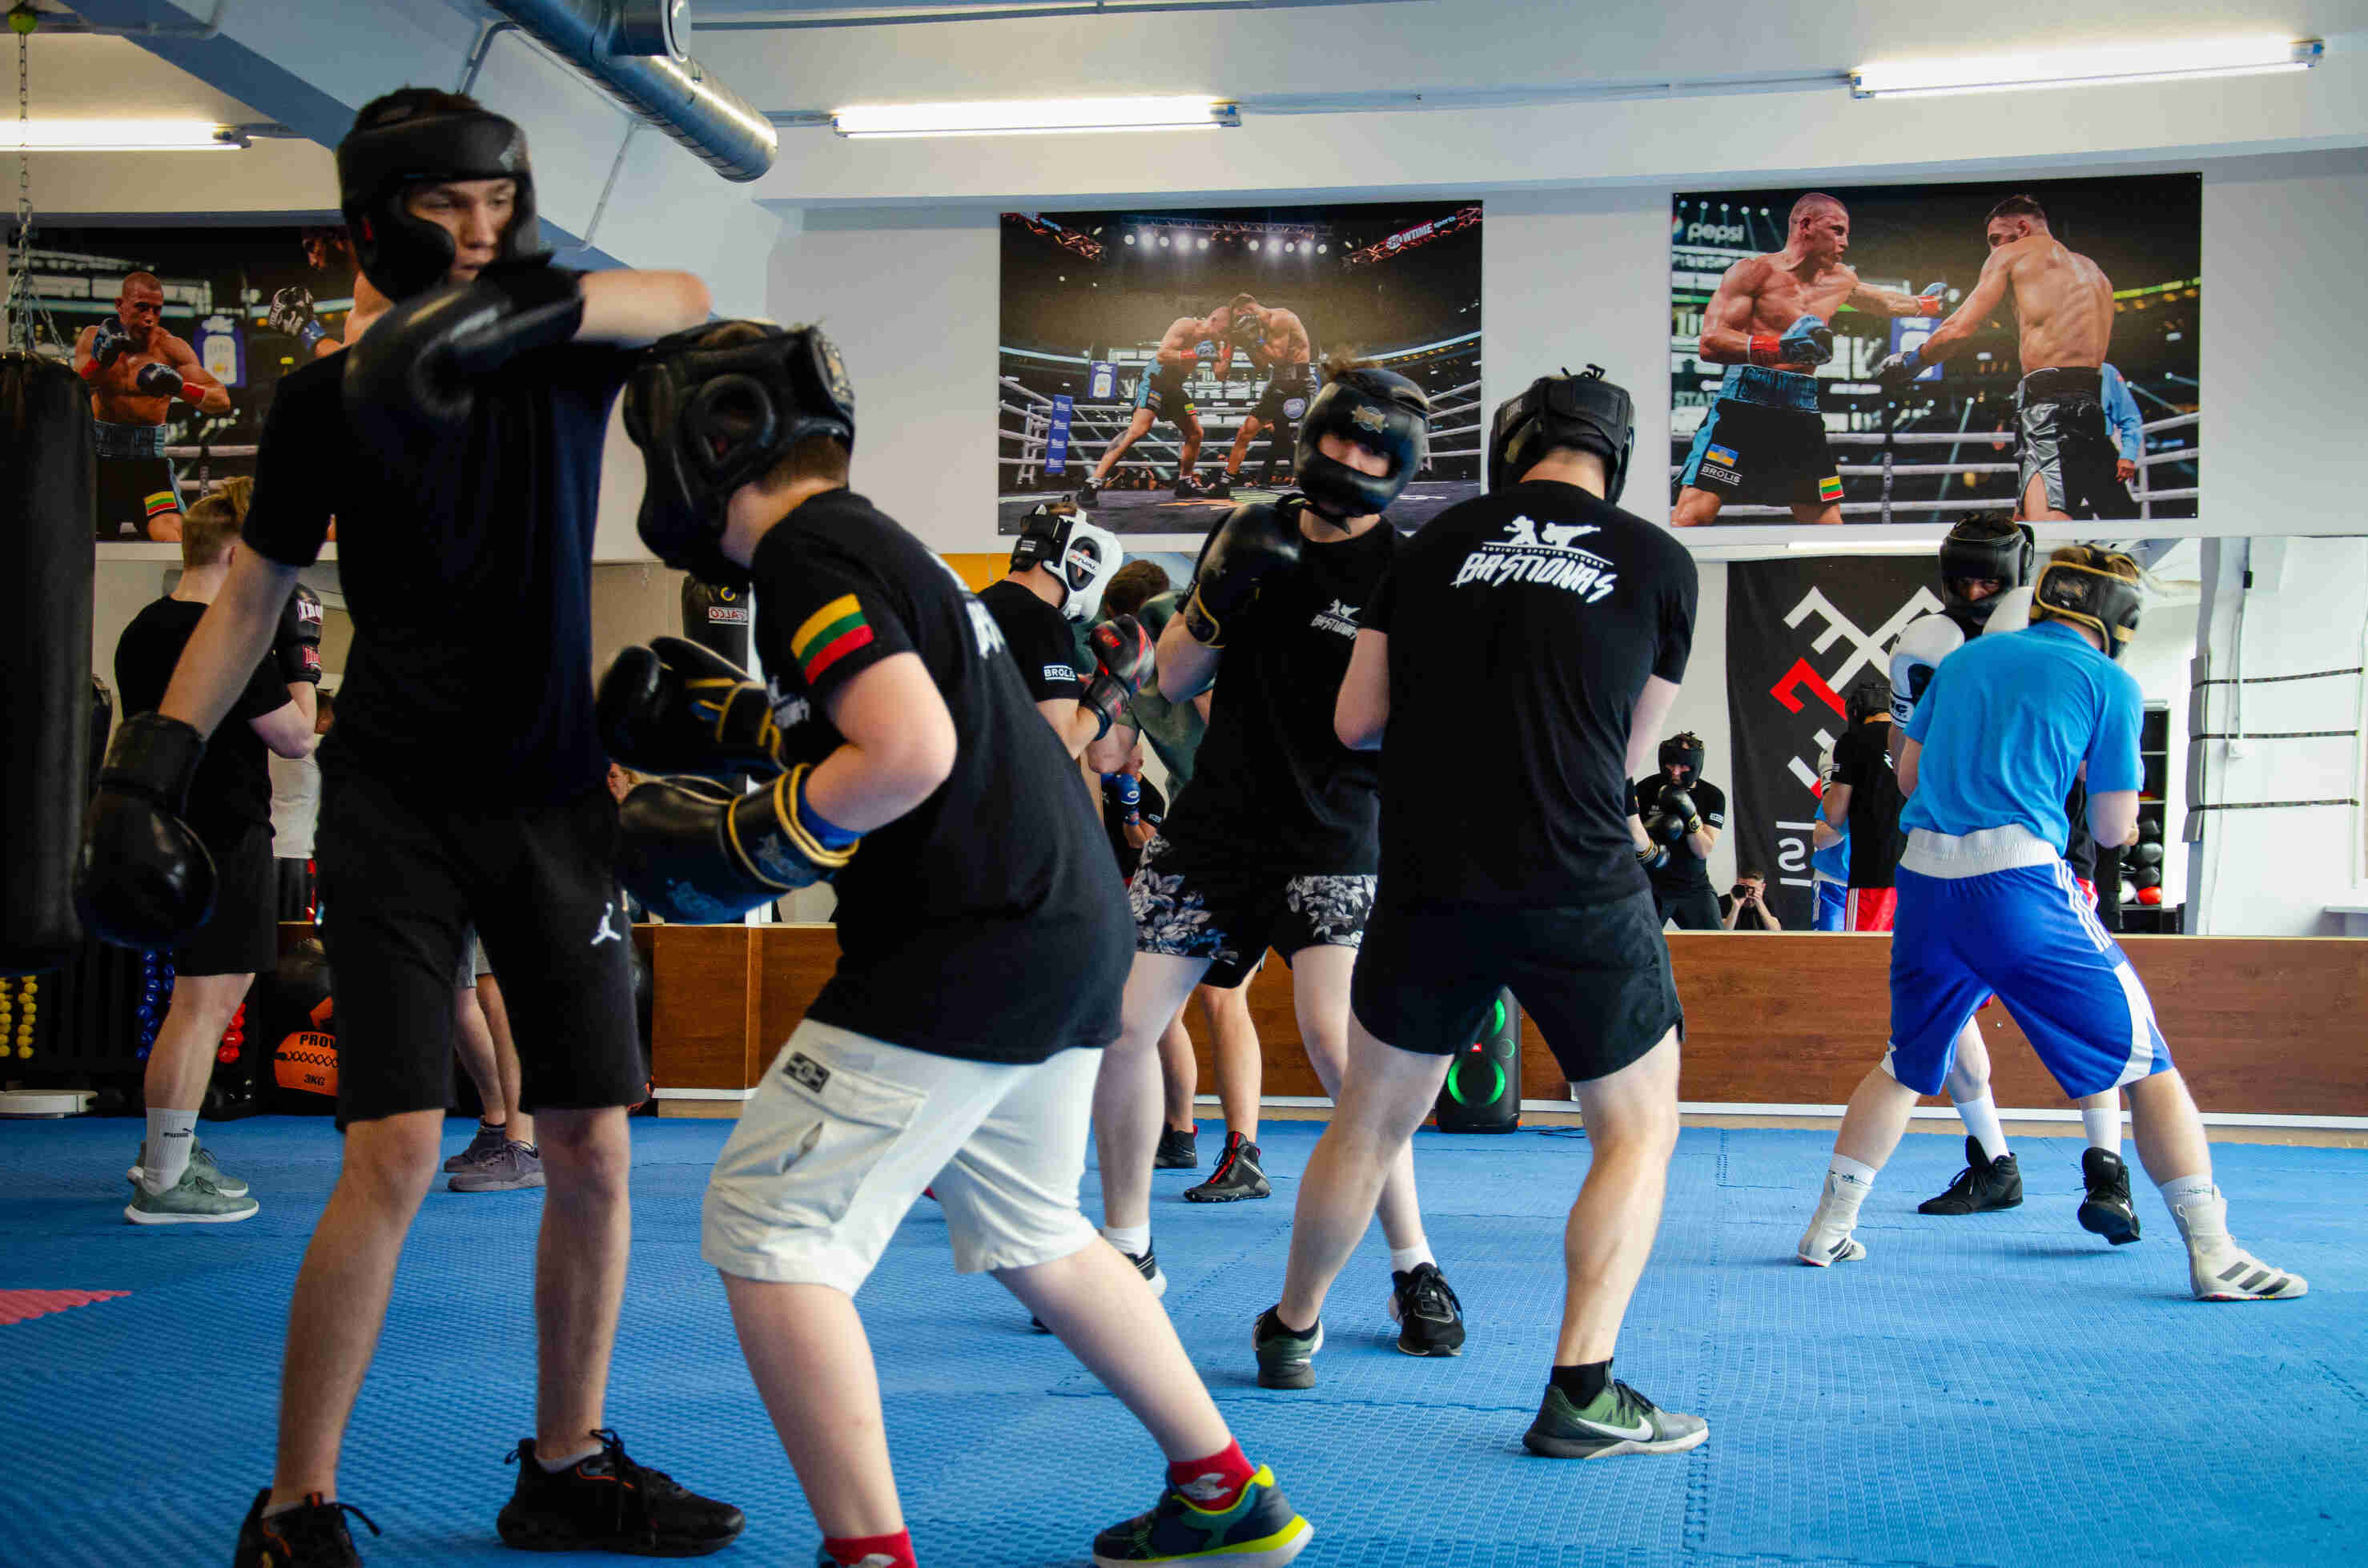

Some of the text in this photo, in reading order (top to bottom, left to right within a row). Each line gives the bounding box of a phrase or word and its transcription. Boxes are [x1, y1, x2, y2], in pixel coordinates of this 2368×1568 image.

[1687, 222, 1744, 243] pepsi
[1701, 466, 1741, 483] BROLIS
[1449, 553, 1618, 603] BASTIONAS
[304, 1074, 327, 1086] 3KG
